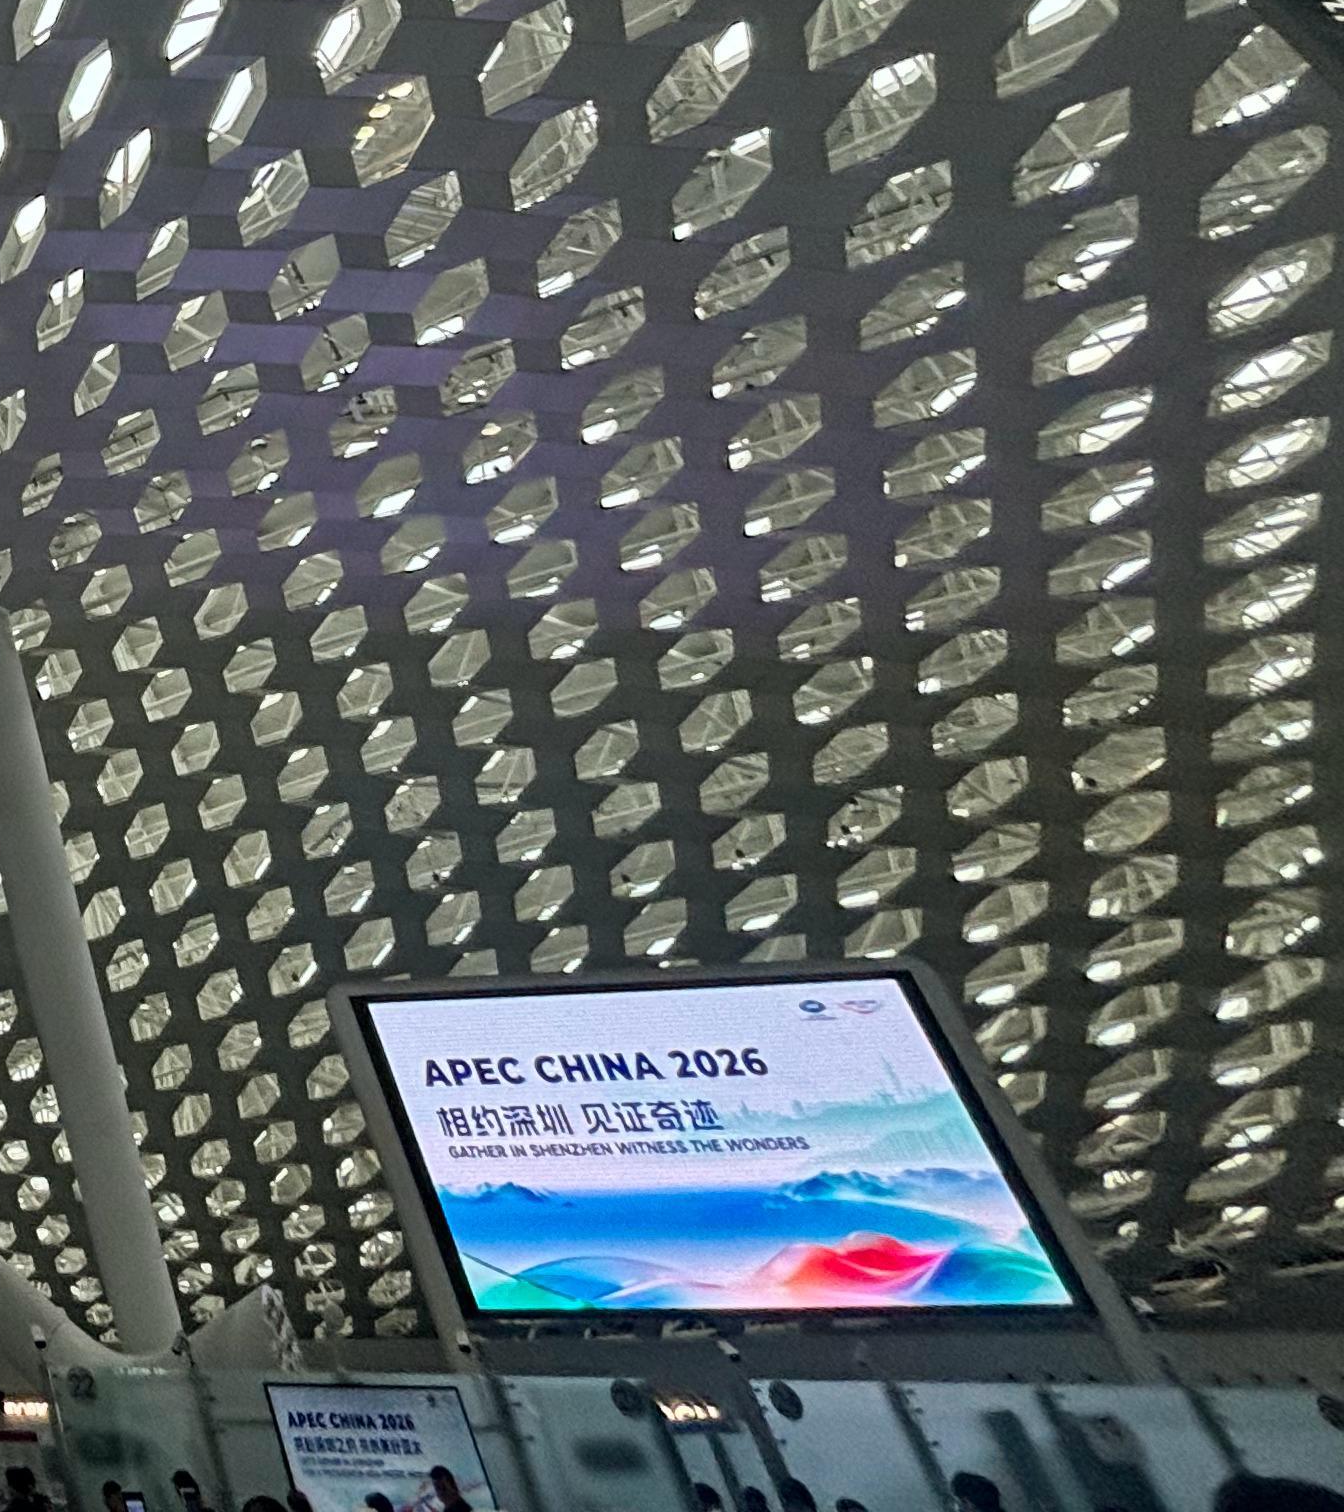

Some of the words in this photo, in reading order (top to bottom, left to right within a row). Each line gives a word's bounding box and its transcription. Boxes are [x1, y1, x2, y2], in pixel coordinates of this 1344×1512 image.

[425, 1056, 526, 1088] APEC
[533, 1051, 666, 1084] CHINA
[668, 1047, 769, 1079] 2026
[437, 1103, 576, 1139] 相约深圳
[581, 1099, 726, 1136] 见证奇迹
[448, 1143, 509, 1160] GATHER
[511, 1144, 528, 1159] IN
[530, 1142, 614, 1159] SHENZHEN
[616, 1140, 689, 1157] WITNESS
[690, 1138, 722, 1154] THE
[724, 1136, 811, 1153] WONDERS
[288, 1411, 327, 1428] APEC
[329, 1412, 378, 1430] CHINA
[378, 1413, 415, 1431] 2026
